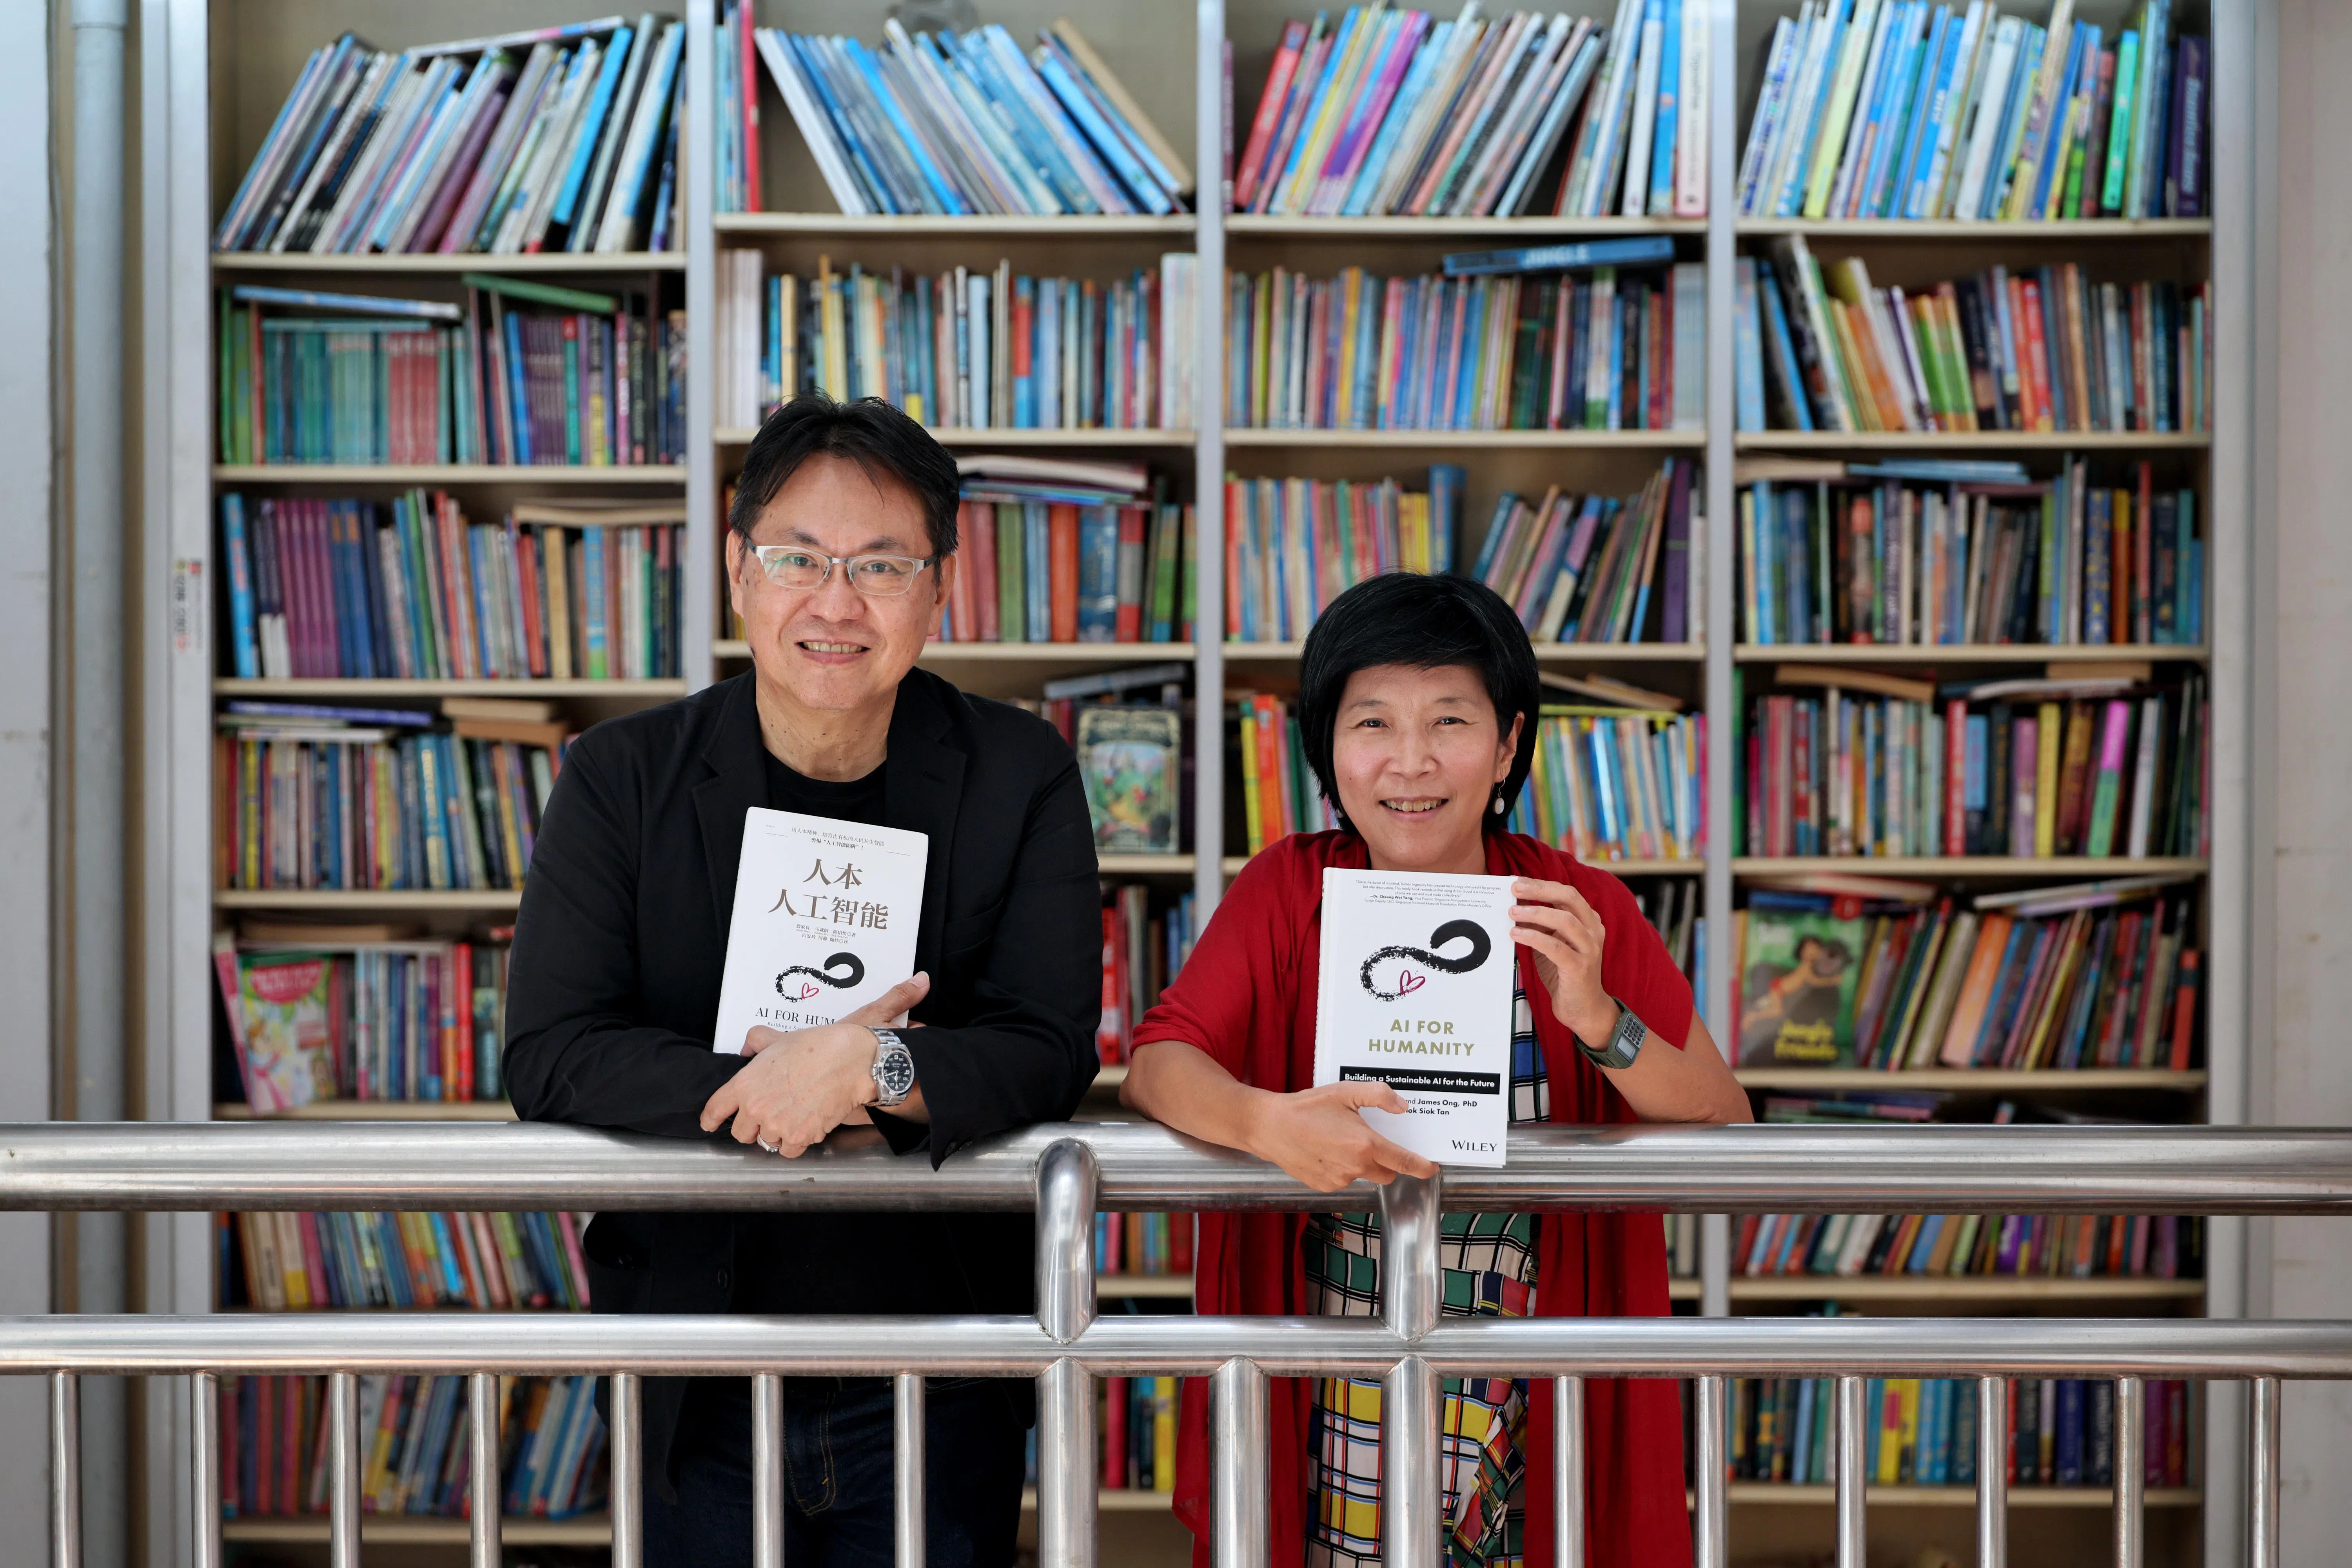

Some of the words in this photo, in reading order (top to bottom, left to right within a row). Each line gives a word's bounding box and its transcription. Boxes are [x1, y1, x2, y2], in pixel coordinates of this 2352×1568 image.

[802, 858, 863, 889] 人本
[768, 889, 889, 929] 人工智能
[755, 1007, 769, 1018] AI
[775, 1010, 799, 1022] FOR
[805, 1014, 835, 1025] HUM
[1390, 1019, 1409, 1032] AI
[1417, 1020, 1454, 1034] FOR
[1368, 1038, 1475, 1056] HUMANITY
[1345, 1073, 1376, 1082] Building
[1385, 1075, 1431, 1084] Sustainable
[1452, 1140, 1497, 1152] WILEY
